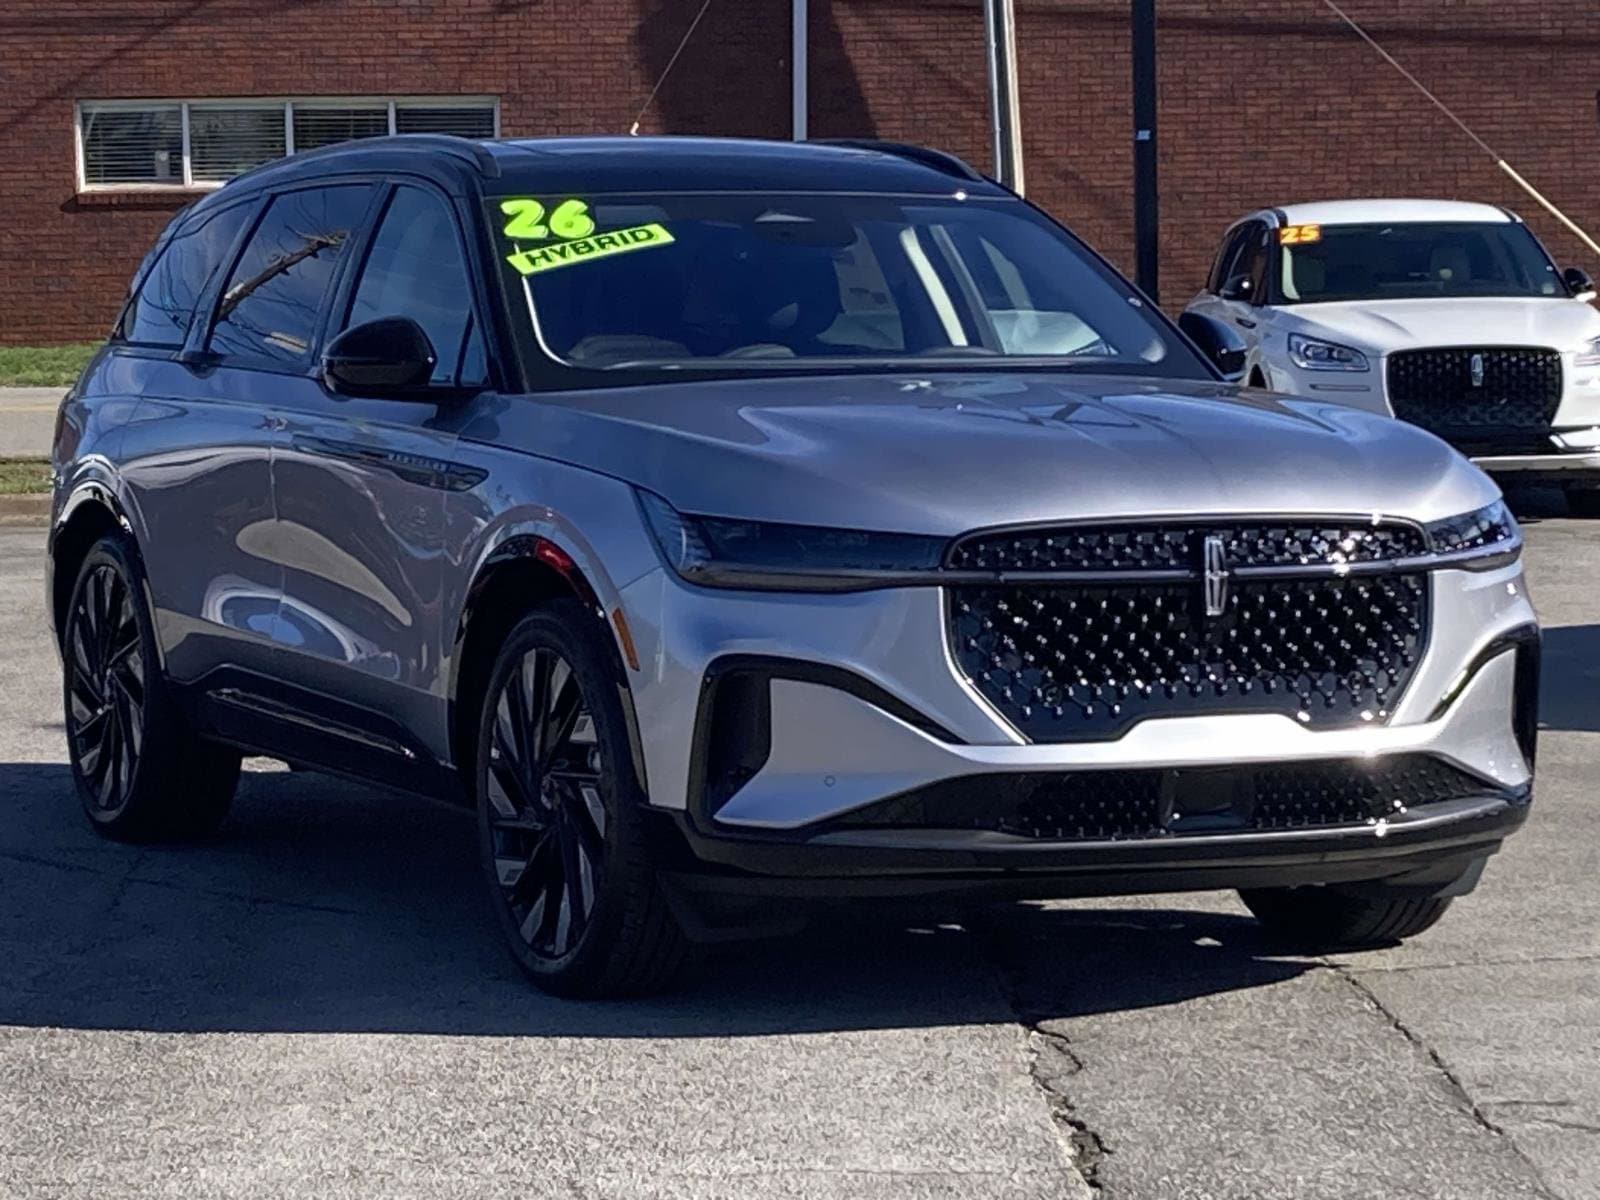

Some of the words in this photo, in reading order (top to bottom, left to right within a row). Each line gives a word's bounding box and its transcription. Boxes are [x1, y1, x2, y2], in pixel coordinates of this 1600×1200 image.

[500, 199, 595, 239] 26
[1280, 224, 1320, 243] 25
[525, 228, 655, 266] HYBRID
